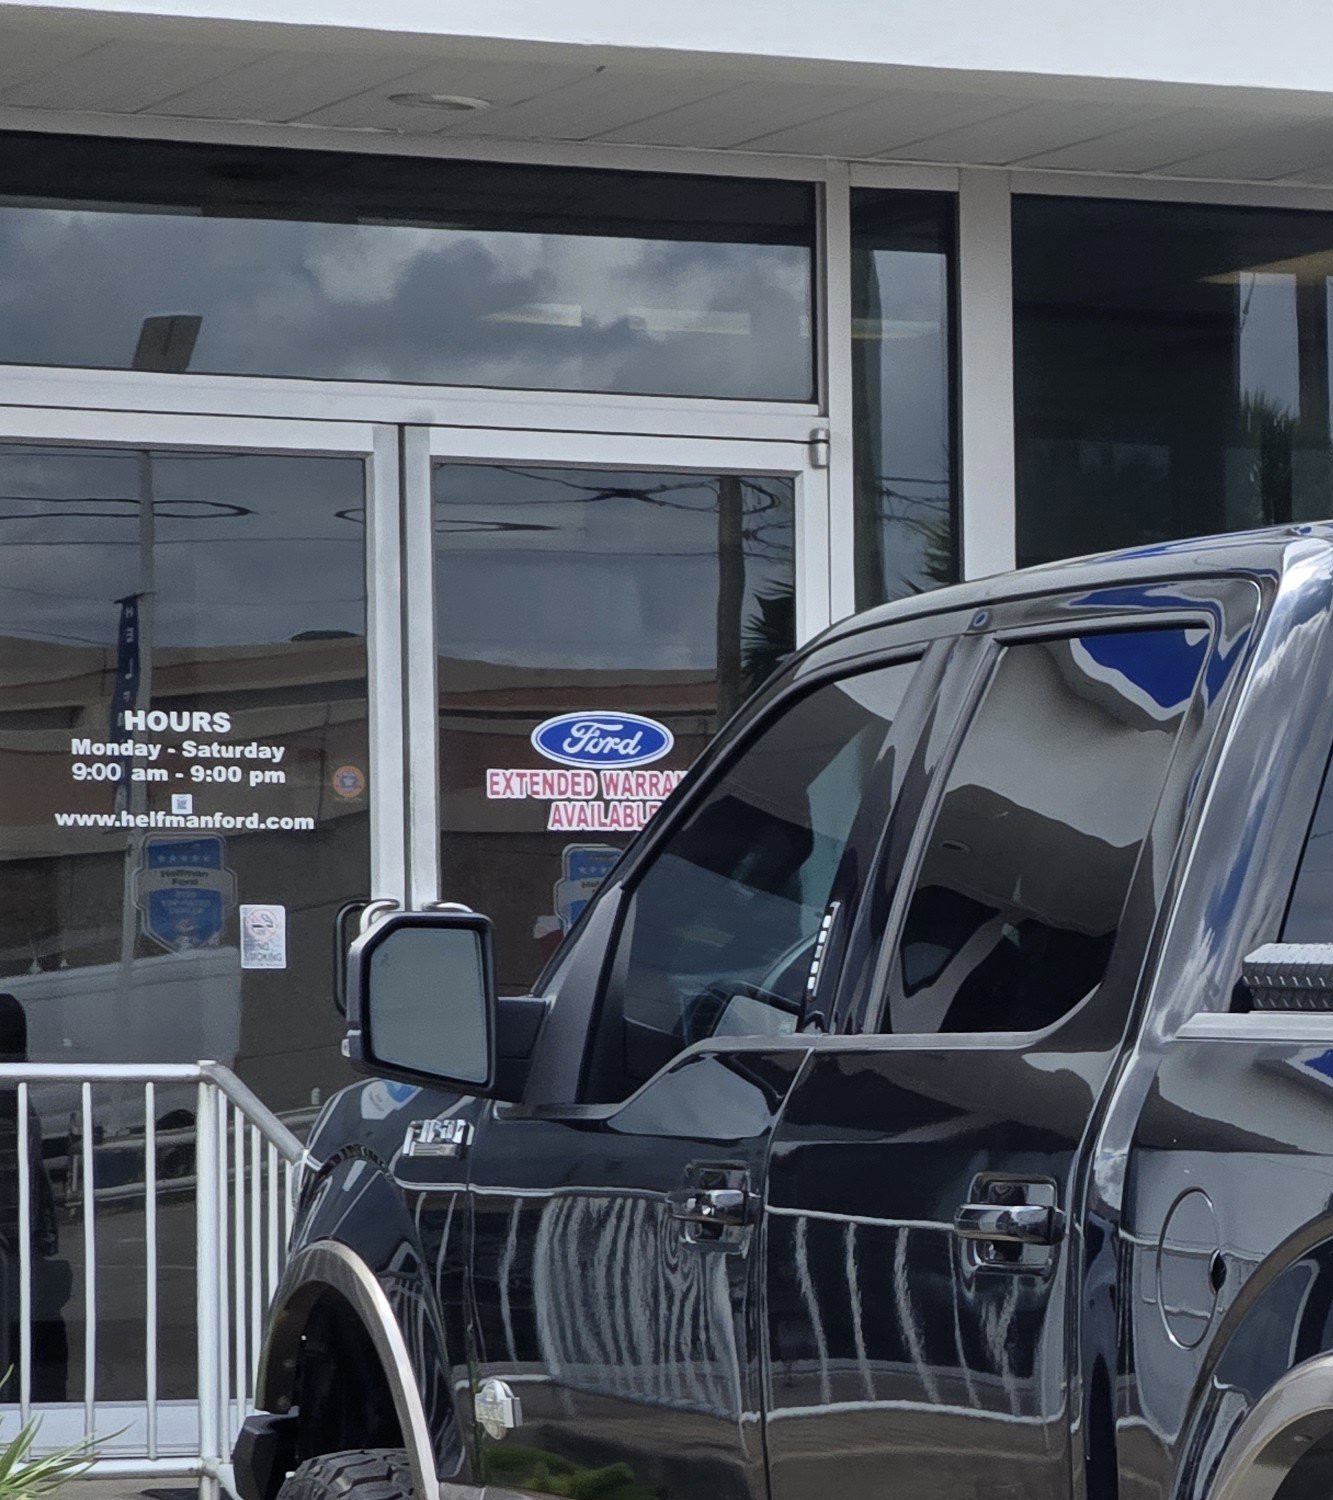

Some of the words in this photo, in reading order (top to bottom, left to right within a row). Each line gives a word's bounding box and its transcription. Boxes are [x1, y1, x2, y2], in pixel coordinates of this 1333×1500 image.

[124, 710, 231, 733] HOURS
[71, 738, 161, 760] Monday
[182, 740, 285, 762] Saturday
[562, 721, 644, 755] Ford
[71, 762, 122, 781] 9:00
[131, 767, 169, 781] am
[190, 765, 242, 783] 9:00
[249, 769, 286, 787] pm
[488, 771, 596, 798] EXTENDED
[602, 772, 684, 798] WARRA
[55, 811, 315, 831] www.helfmanford.com
